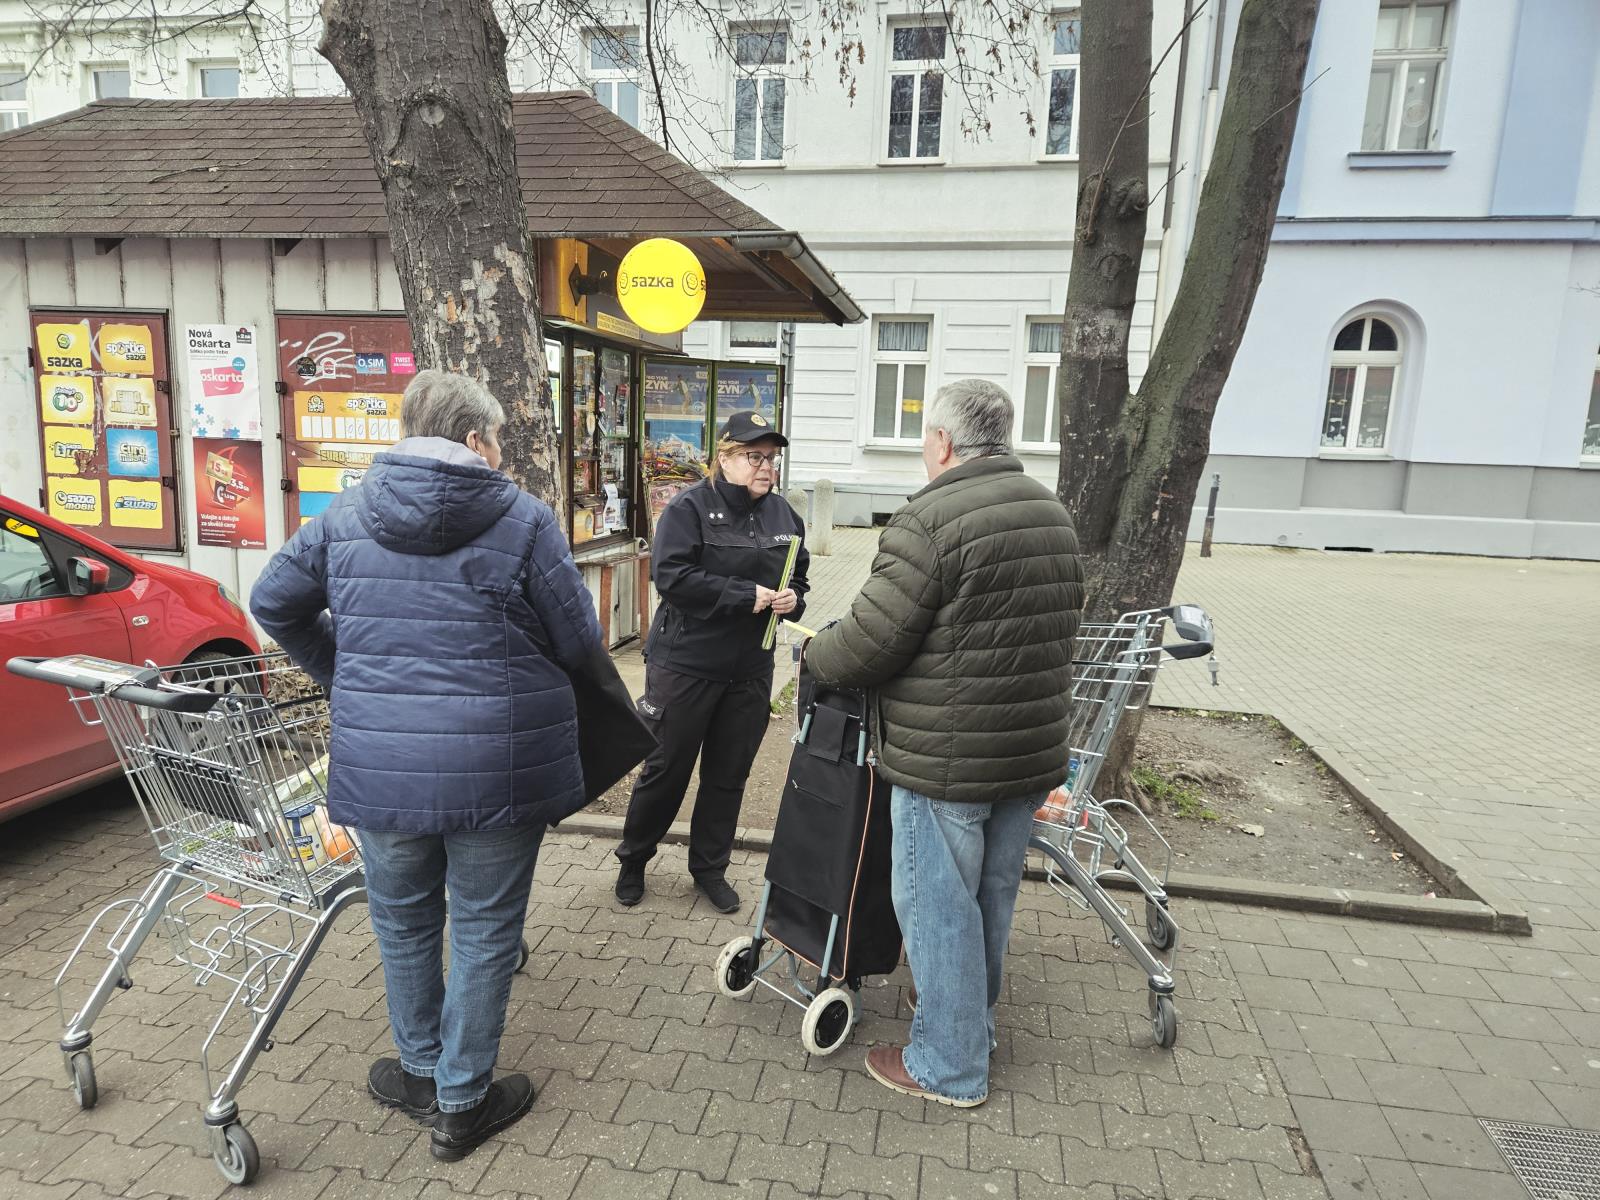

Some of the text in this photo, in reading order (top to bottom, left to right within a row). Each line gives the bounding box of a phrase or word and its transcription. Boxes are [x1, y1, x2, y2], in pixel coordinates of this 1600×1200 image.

[631, 276, 674, 288] sazka
[189, 329, 212, 338] Nová
[106, 341, 147, 356] sportka
[190, 339, 231, 348] Oskarta
[47, 356, 83, 368] sazka
[201, 369, 245, 383] oskarta
[645, 380, 669, 390] ZYN
[717, 384, 740, 394] ZYN
[347, 399, 387, 410] sportka
[66, 493, 96, 504] sazka
